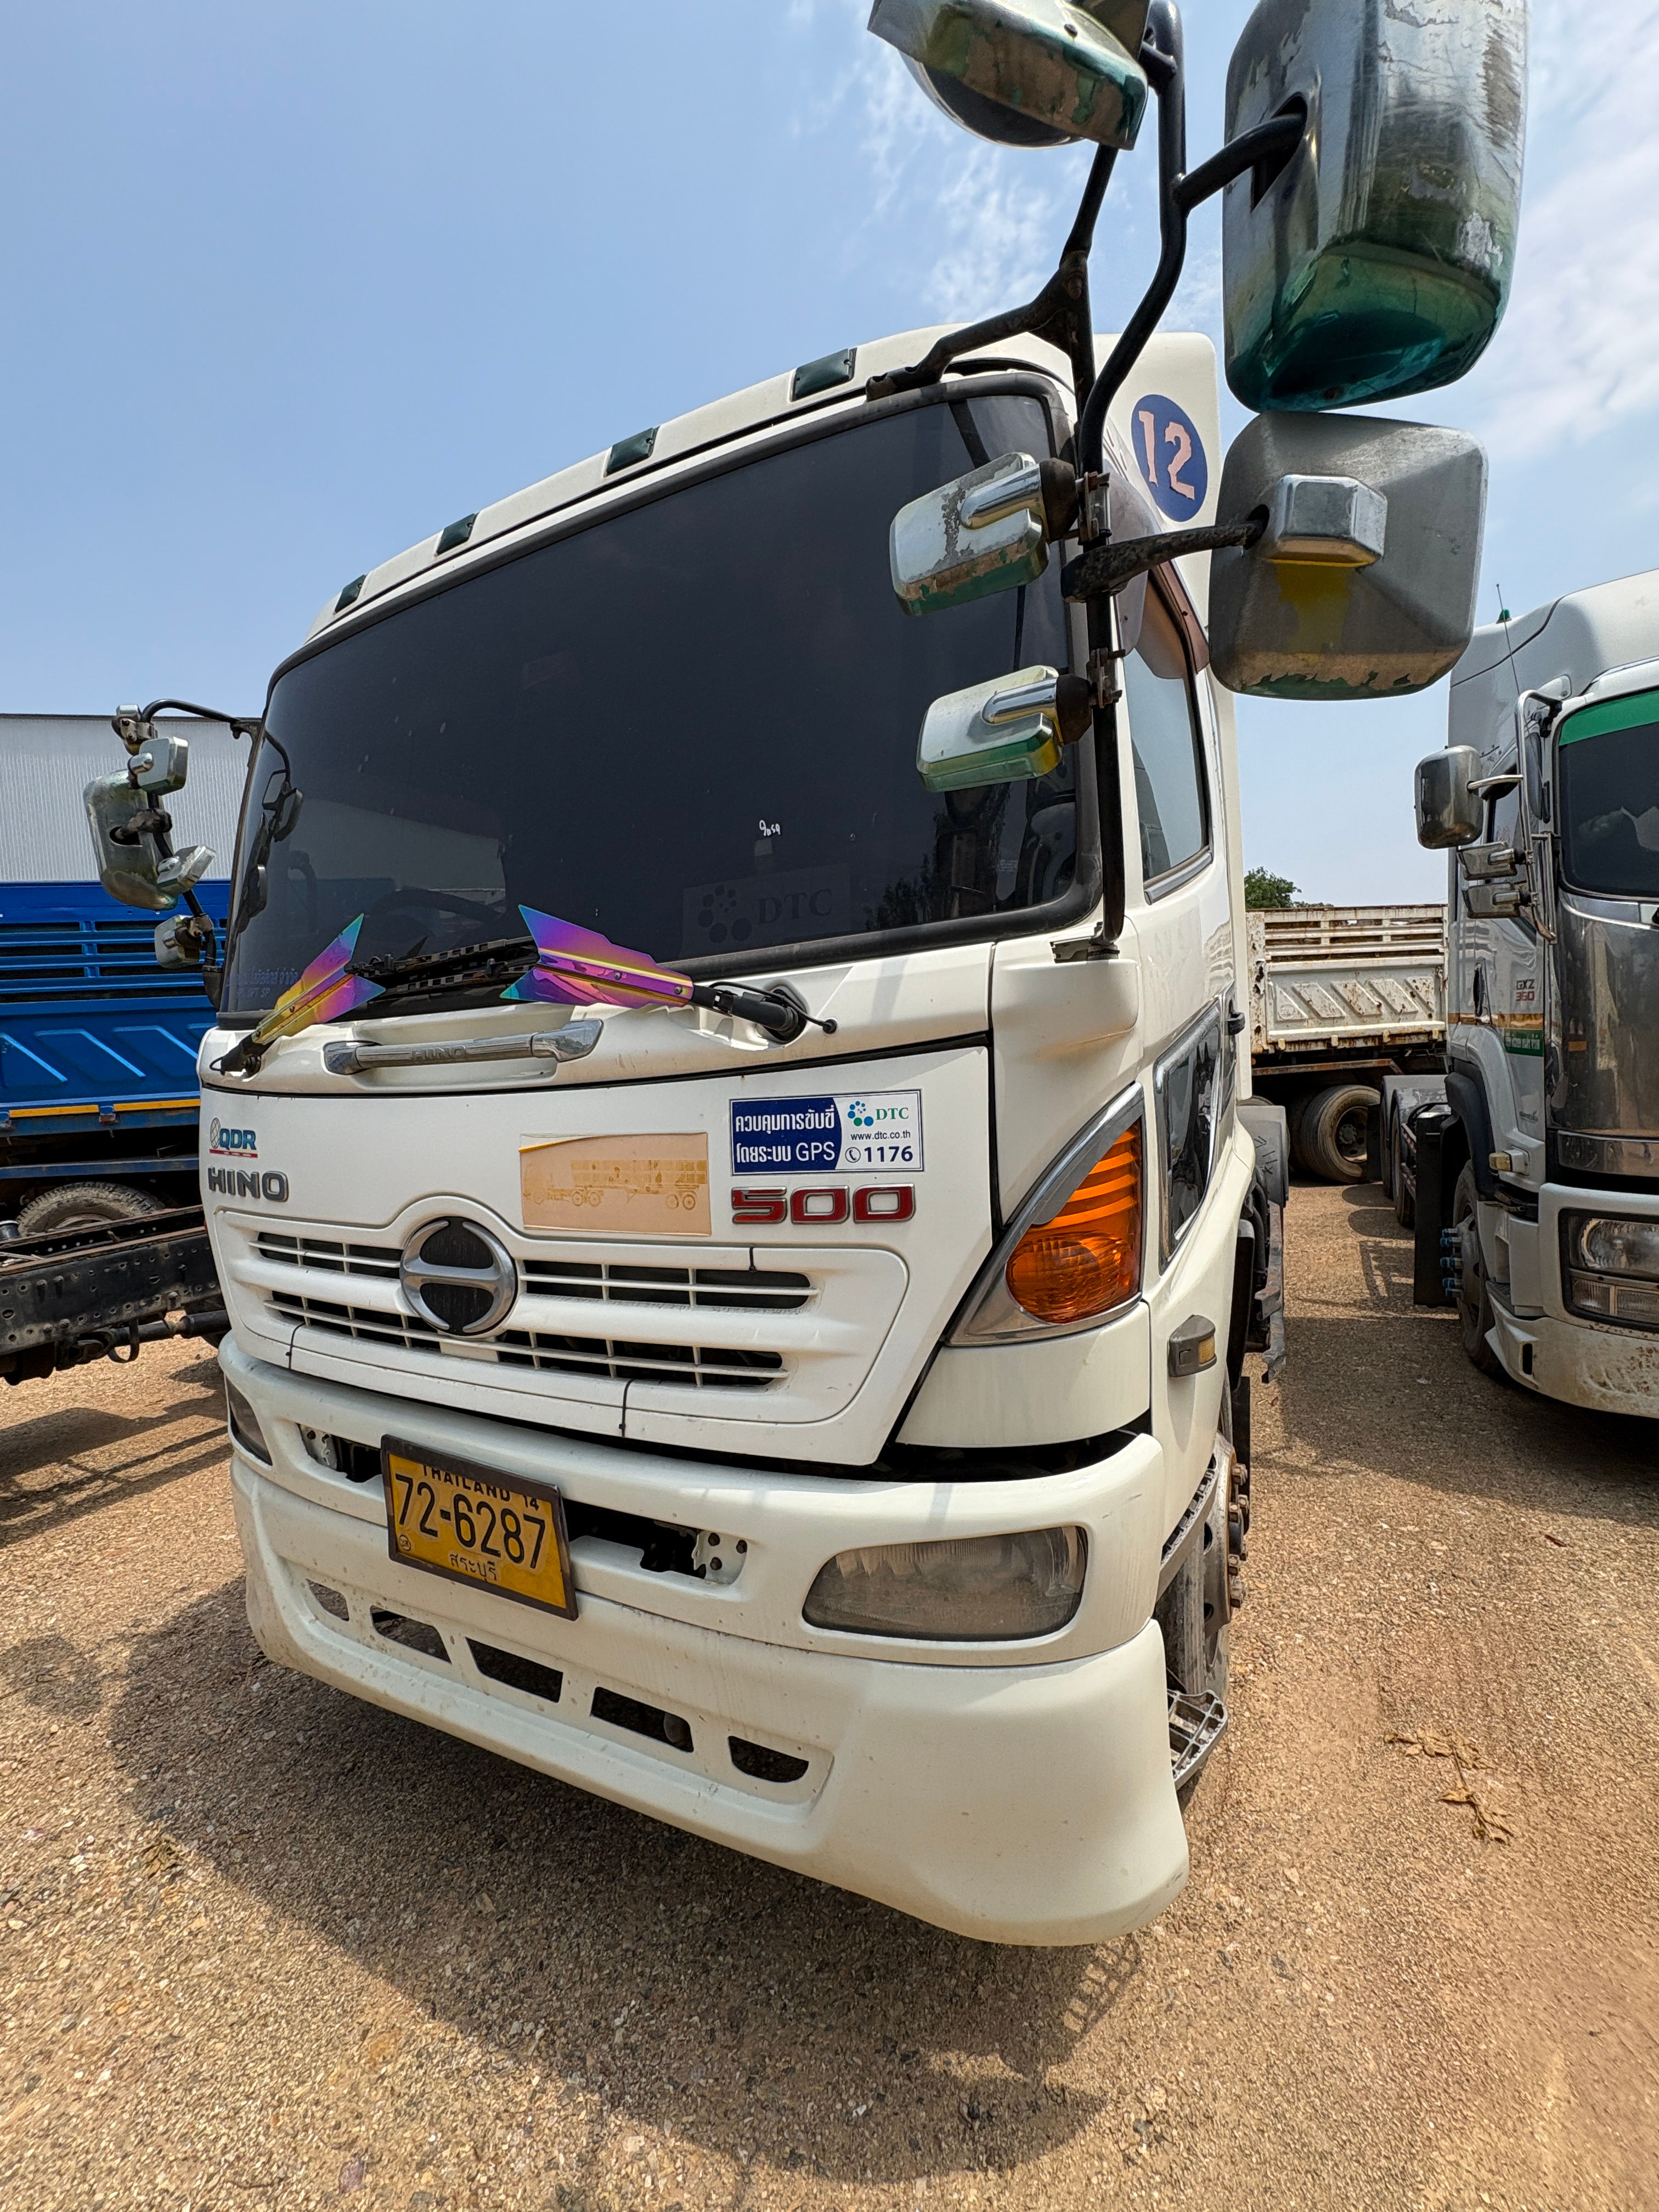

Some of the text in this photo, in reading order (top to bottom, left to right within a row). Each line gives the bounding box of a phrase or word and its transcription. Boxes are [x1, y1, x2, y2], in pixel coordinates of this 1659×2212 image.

[1138, 410, 1195, 500] 12
[757, 888, 833, 925] DTC
[1516, 979, 1535, 990] GXZ
[411, 1045, 467, 1062] HINO
[735, 1105, 835, 1135] ควบคุมการขับขี่
[875, 1107, 910, 1121] DTC
[219, 1127, 257, 1150] QDR
[850, 1130, 911, 1141] www.dtc.co.th
[736, 1142, 836, 1163] โดยระบบ GPS
[864, 1146, 913, 1163] 1176
[207, 1166, 289, 1203] HINO
[731, 1183, 917, 1224] 500
[422, 1465, 511, 1502] THAILAND
[395, 1473, 546, 1569] 72-6287
[449, 1553, 497, 1583] สระบุรี
